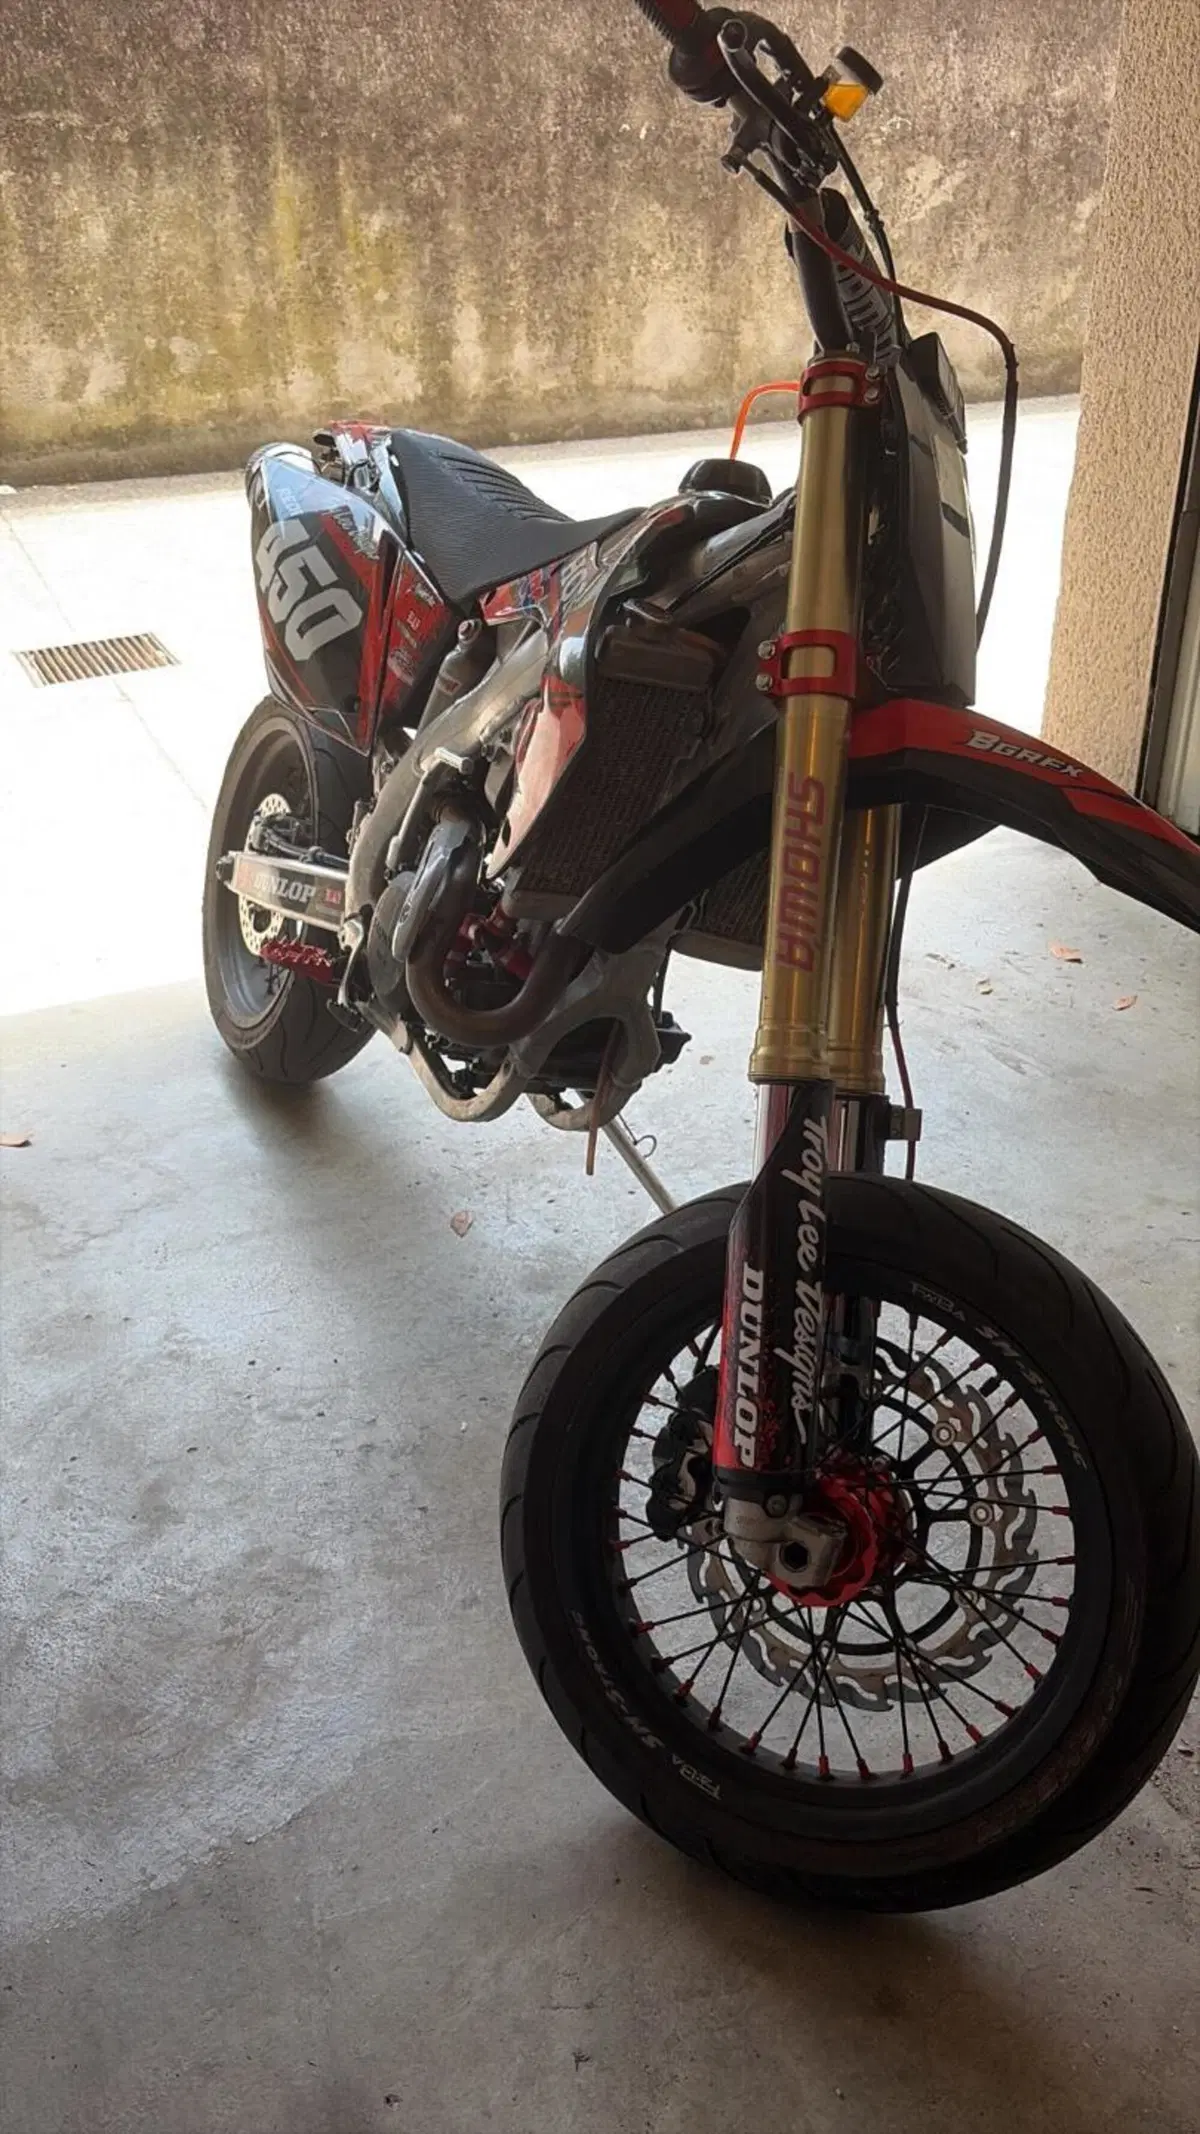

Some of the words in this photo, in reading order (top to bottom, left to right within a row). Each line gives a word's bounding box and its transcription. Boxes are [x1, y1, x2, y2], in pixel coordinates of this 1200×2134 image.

[256, 518, 363, 661] 450
[252, 872, 316, 904] DUNLOP
[773, 772, 825, 972] SHOWA
[781, 1114, 827, 1197] Troy
[796, 1198, 826, 1276] Lee
[732, 1261, 765, 1468] DUNLOP
[773, 1280, 826, 1448] Designs
